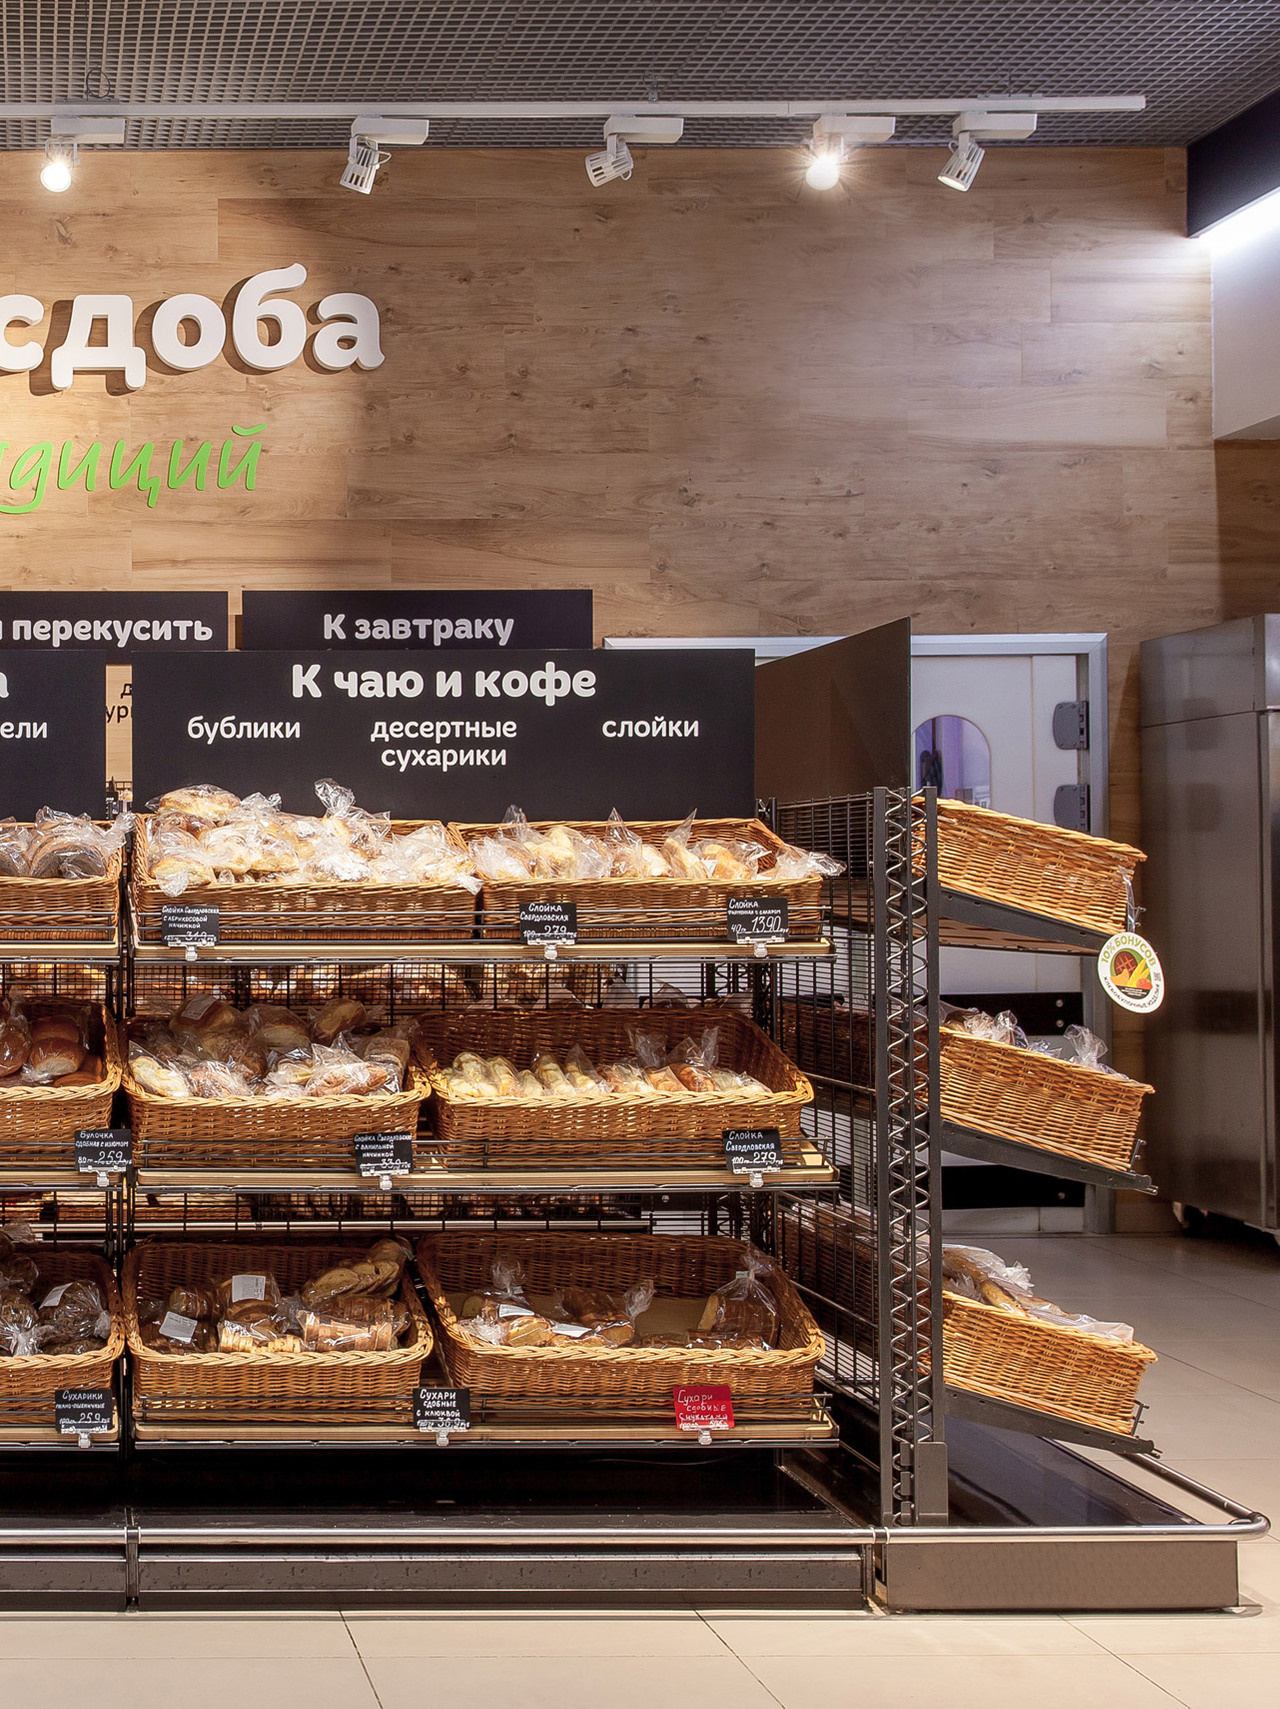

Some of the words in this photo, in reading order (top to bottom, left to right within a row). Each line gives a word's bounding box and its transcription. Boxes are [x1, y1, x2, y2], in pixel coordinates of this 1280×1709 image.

[13, 617, 214, 649] перекусить
[324, 615, 346, 640] К
[354, 616, 515, 646] завтраку
[292, 664, 322, 698] К
[334, 671, 423, 699] чаю
[436, 671, 462, 698] и
[475, 662, 597, 706] кофе
[187, 716, 302, 743] бублики
[370, 718, 518, 743] десертные
[601, 715, 700, 738] слойки
[380, 747, 508, 772] сухарики
[1114, 935, 1157, 967] БОНУСОВ
